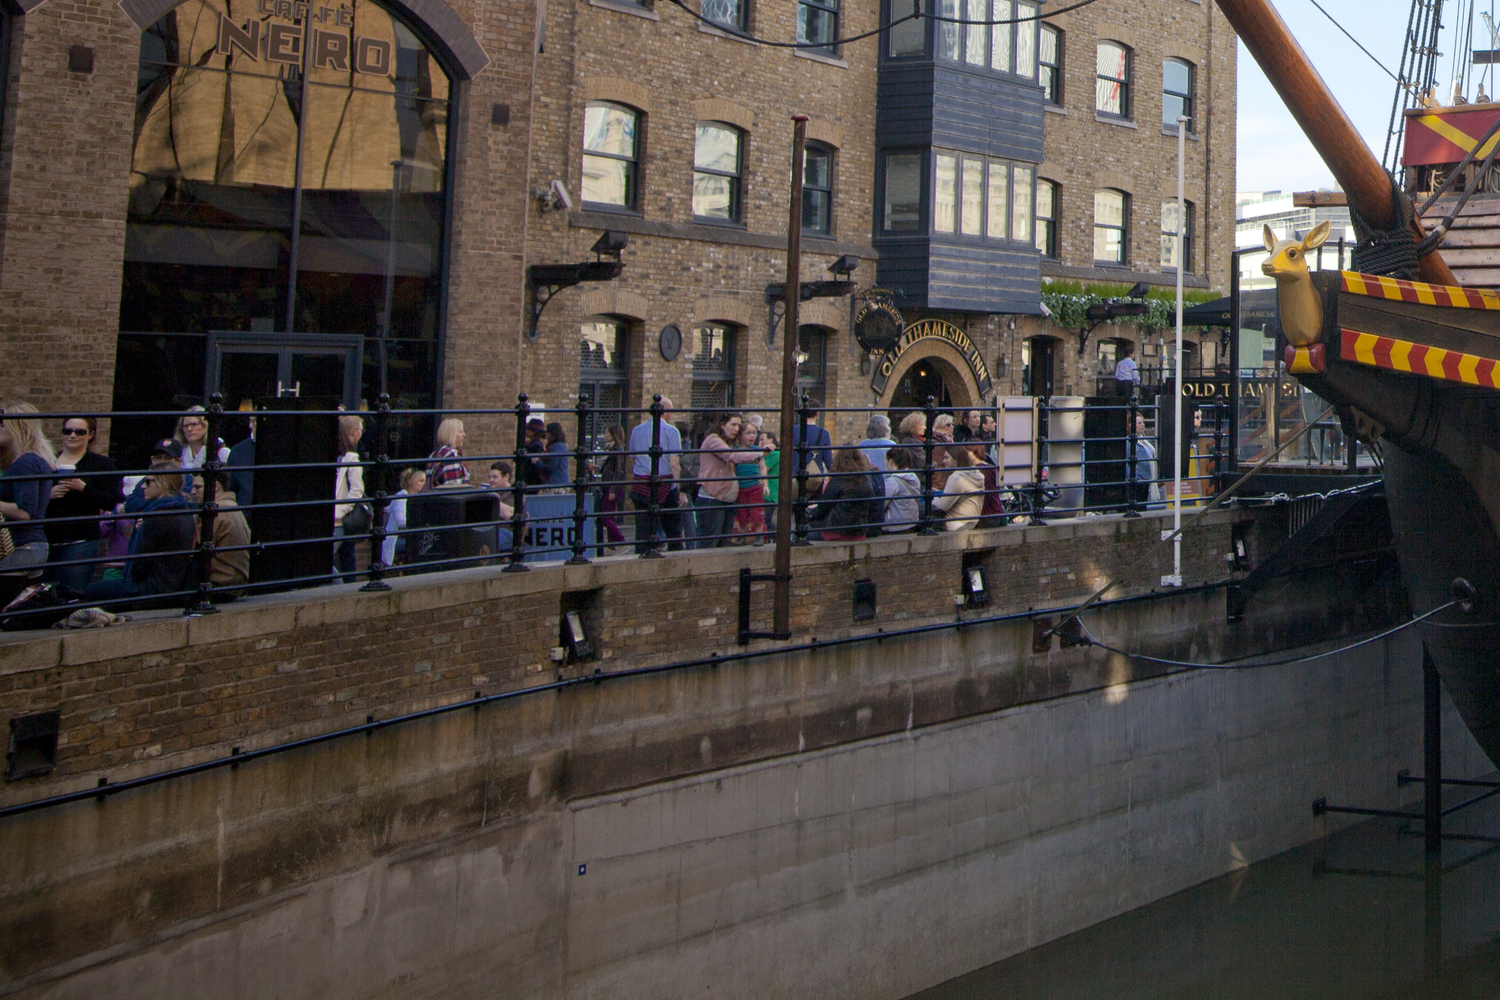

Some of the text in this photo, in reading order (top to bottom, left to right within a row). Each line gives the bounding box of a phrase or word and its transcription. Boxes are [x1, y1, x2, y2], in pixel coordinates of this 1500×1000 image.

[216, 11, 391, 76] NERO
[905, 321, 972, 353] THAMESIDE
[970, 350, 987, 381] INN
[1181, 382, 1215, 397] OLD
